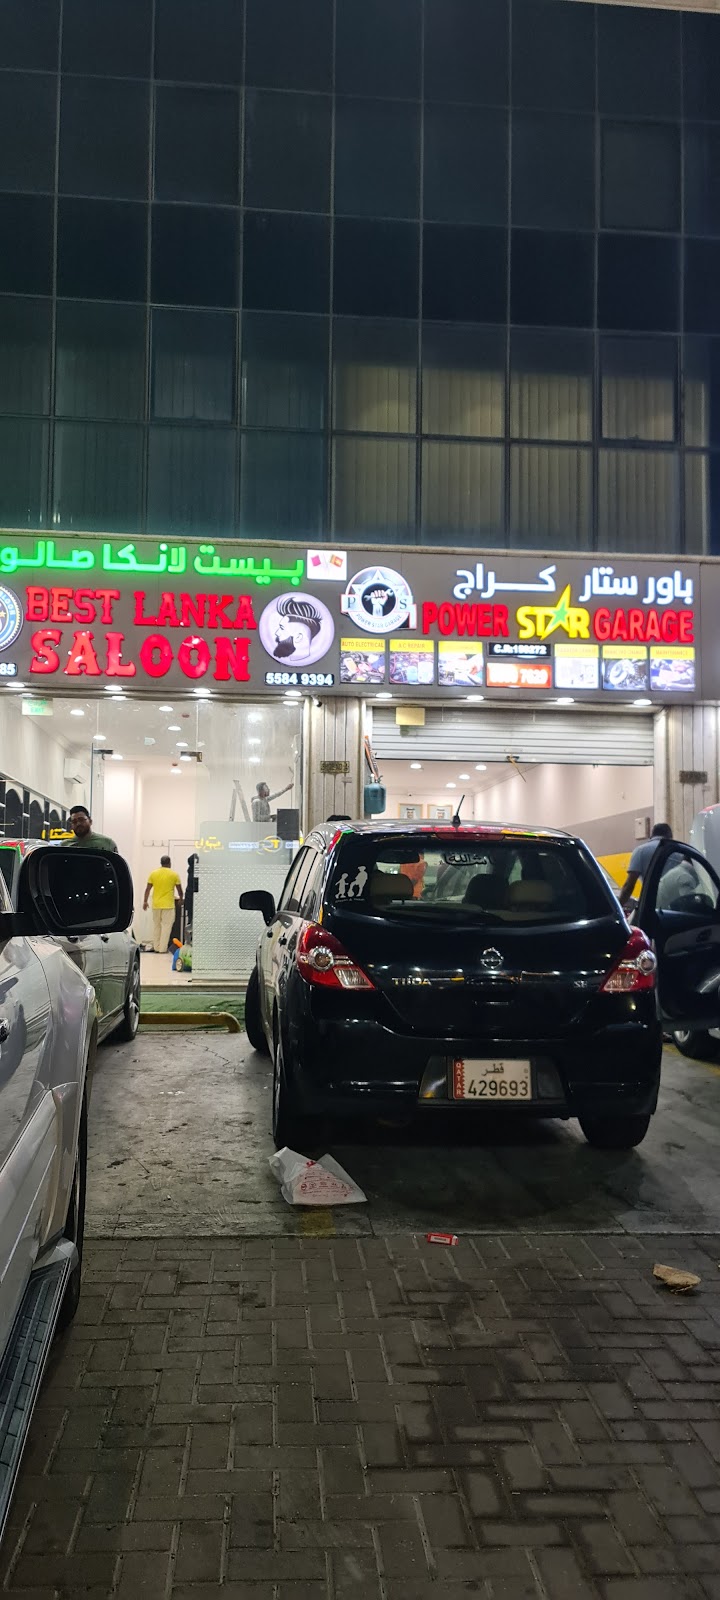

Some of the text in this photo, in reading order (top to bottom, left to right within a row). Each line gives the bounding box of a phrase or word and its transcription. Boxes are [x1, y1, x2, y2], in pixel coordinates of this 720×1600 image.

[102, 542, 188, 573] لانكا
[193, 543, 304, 585] بيست
[453, 562, 694, 606] باور ستار كراج
[24, 585, 258, 631] BEST LANKA
[421, 584, 695, 644] POWER STAR GARAGE
[28, 628, 252, 682] SALOON
[265, 672, 333, 687] 5584 9394
[467, 1079, 529, 1097] 429693
[481, 1062, 505, 1077] قطر
